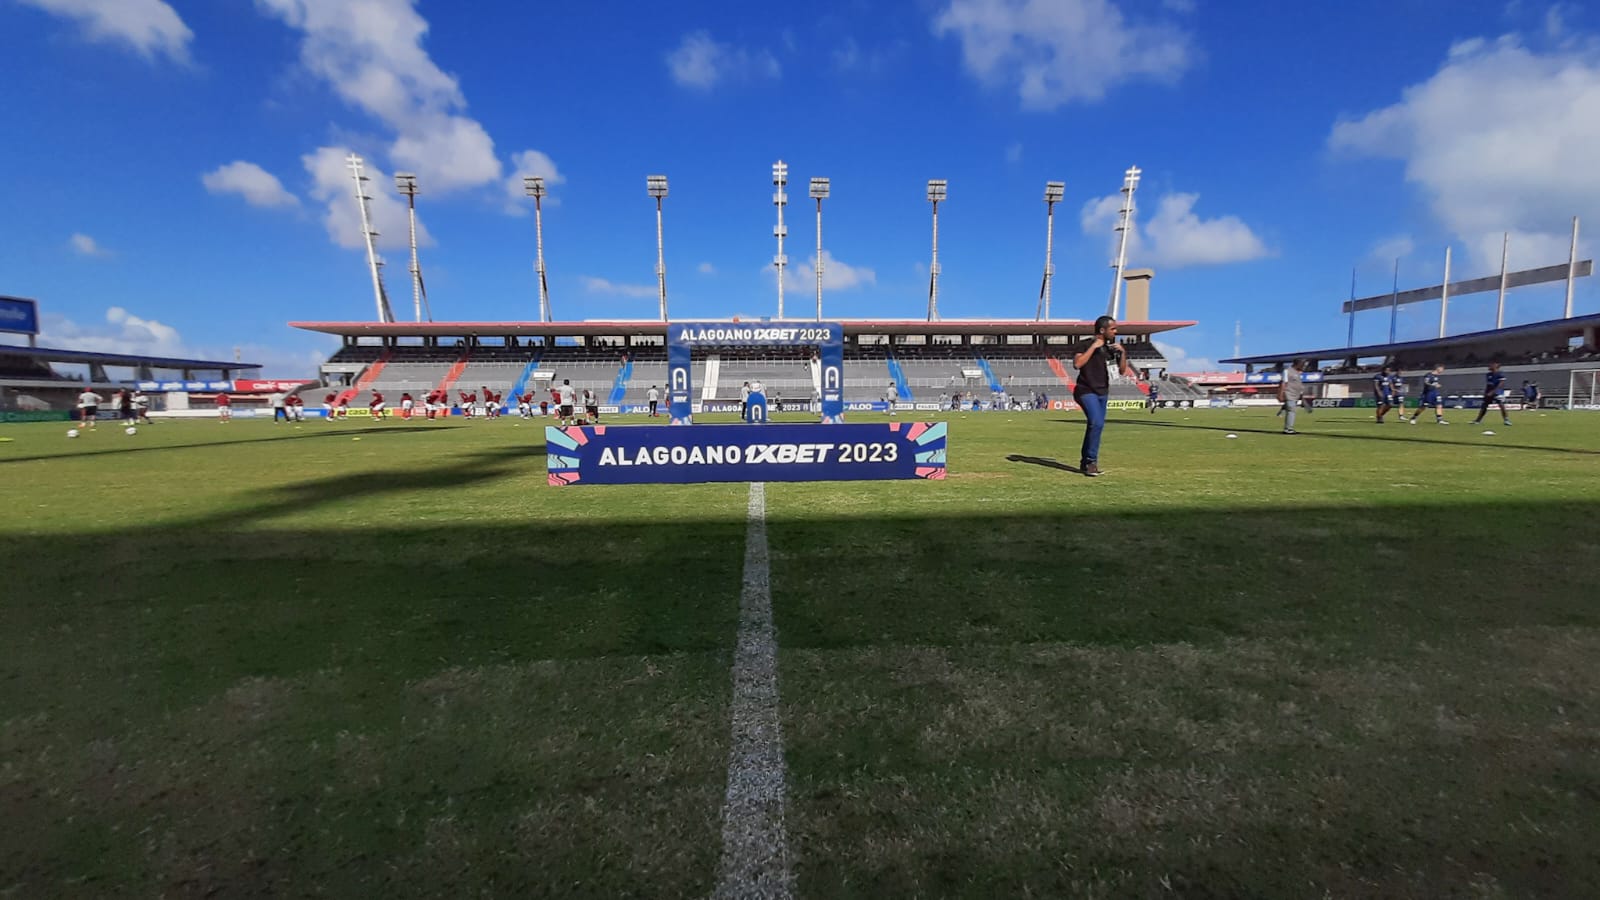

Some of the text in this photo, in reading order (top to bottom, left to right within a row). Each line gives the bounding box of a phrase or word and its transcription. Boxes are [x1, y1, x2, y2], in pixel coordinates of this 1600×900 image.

[680, 328, 831, 341] ALAGOANO 1XBET 2023
[598, 443, 898, 466] ALAGOANO 1XBET 2023
